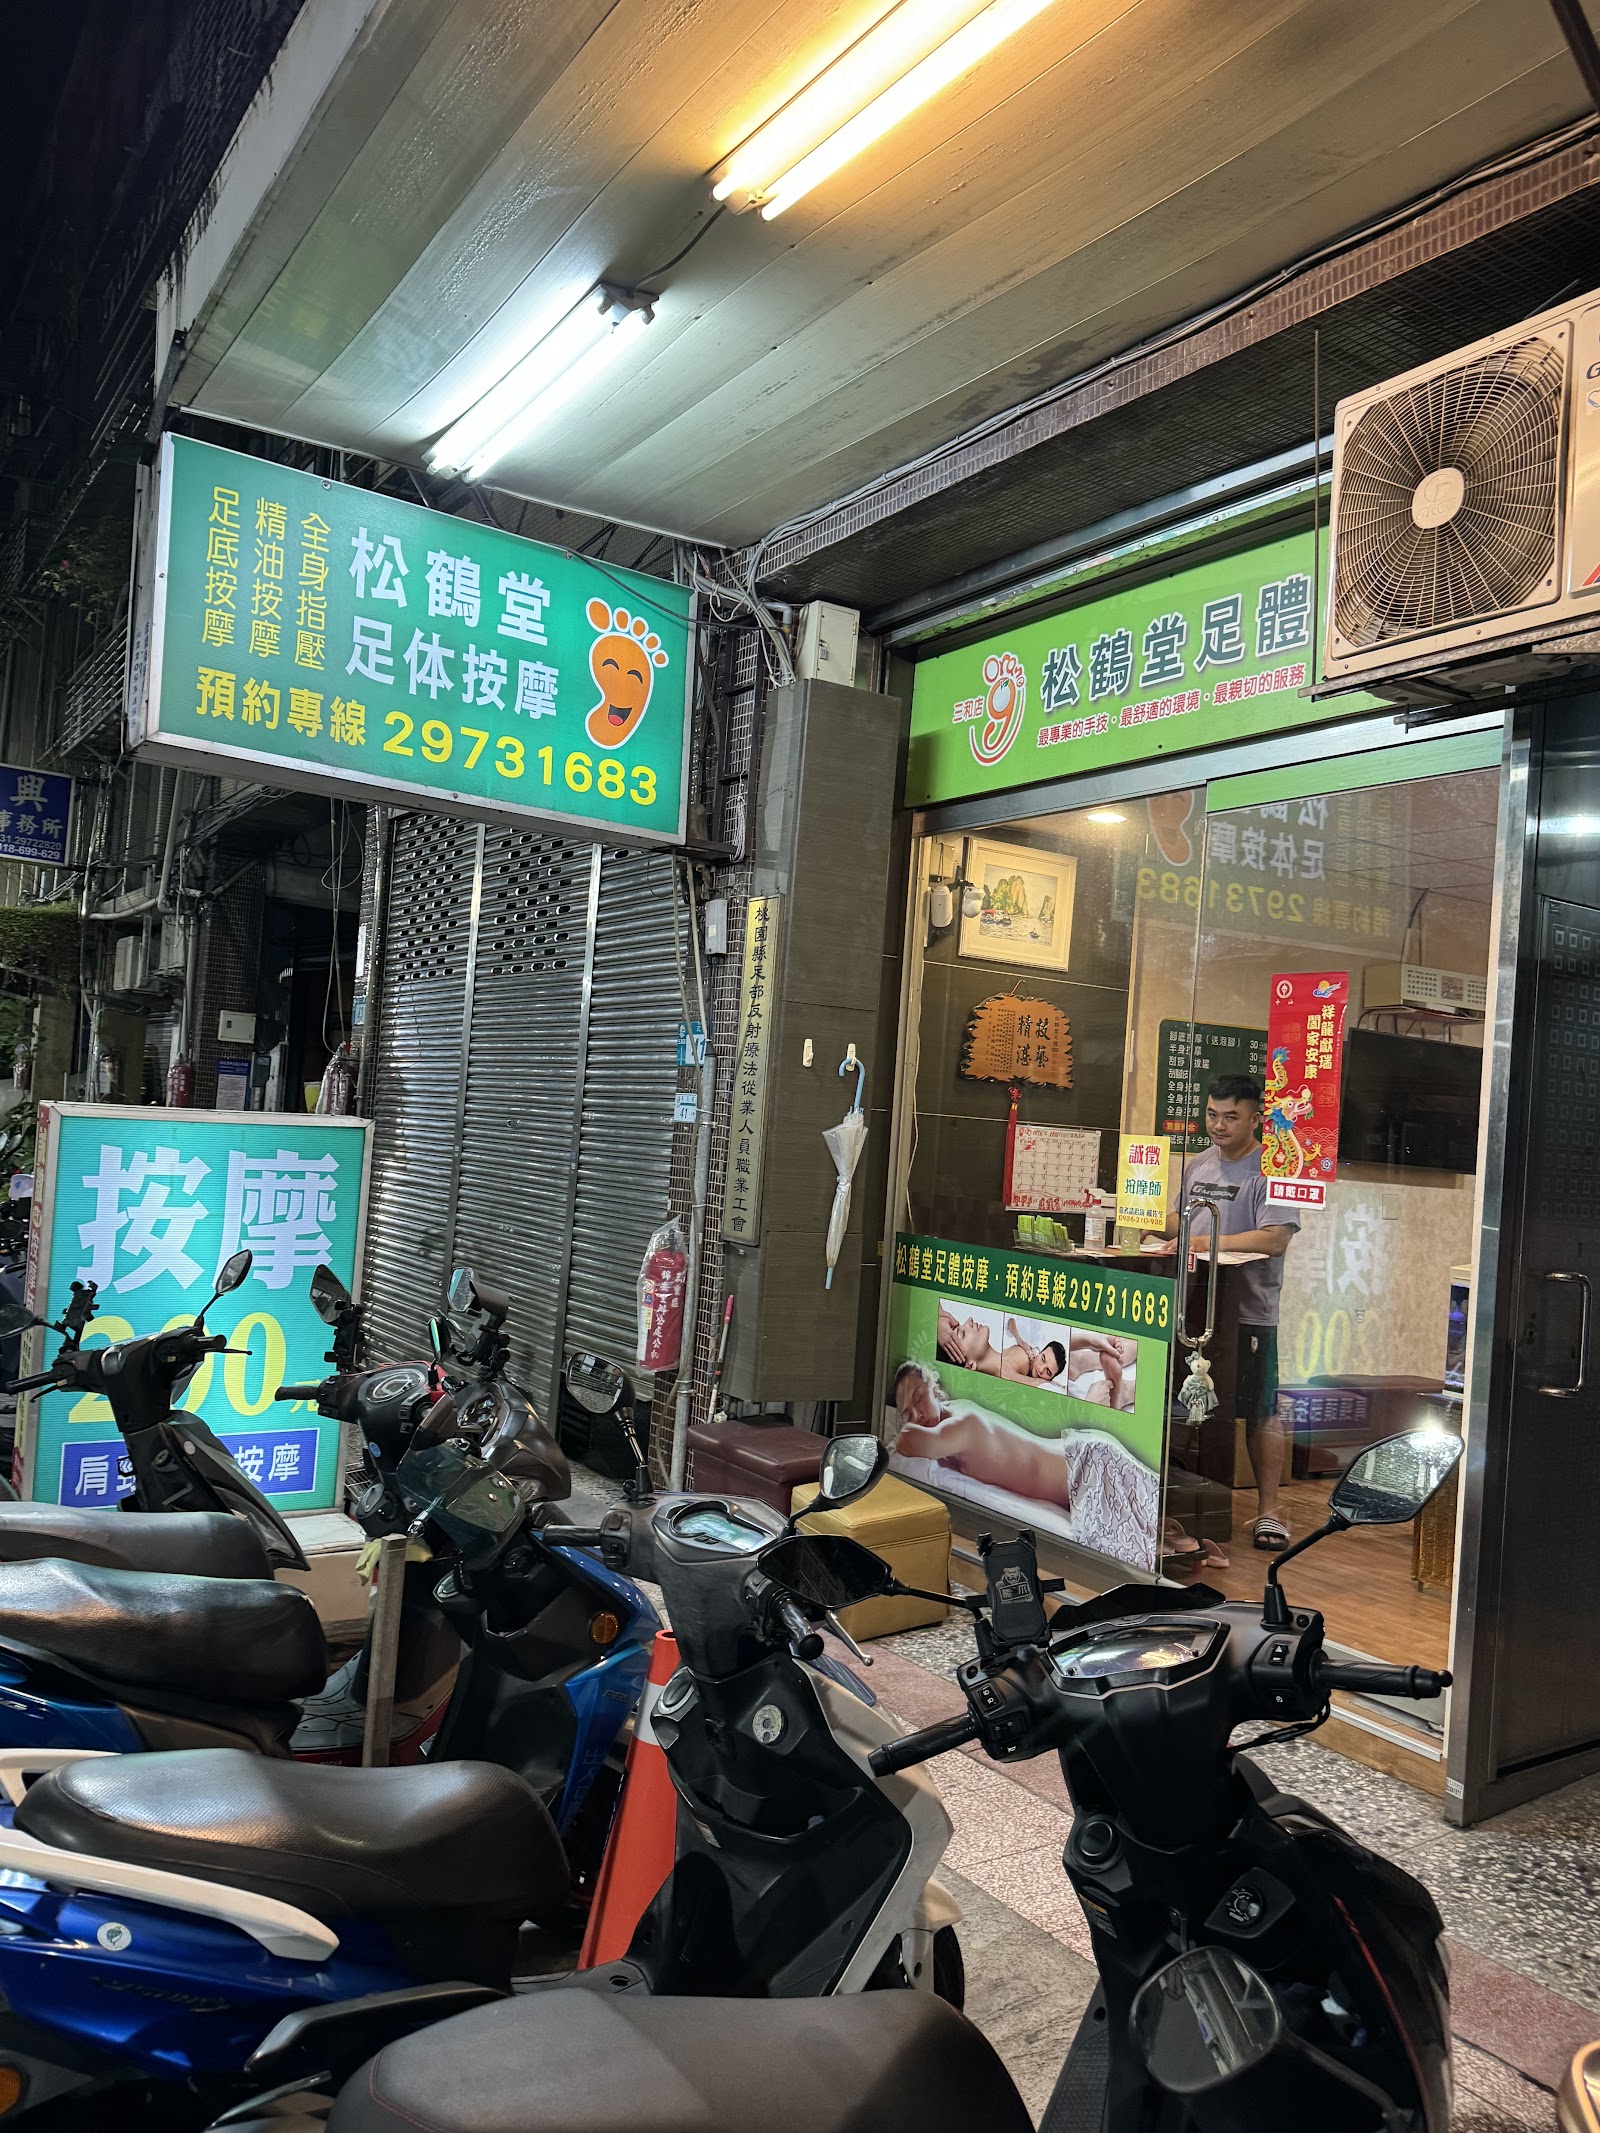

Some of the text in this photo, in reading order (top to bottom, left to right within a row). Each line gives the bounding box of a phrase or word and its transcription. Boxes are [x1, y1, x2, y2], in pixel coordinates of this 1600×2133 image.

[202, 486, 240, 648] 足底按摩
[249, 497, 287, 658] 精油按摩
[295, 512, 331, 671] 全身指壓
[348, 525, 551, 648] 松鶴堂
[345, 616, 560, 721] 足体按摩
[1041, 575, 1311, 711] 松鶴堂足體
[196, 666, 367, 747] 預約專線
[382, 710, 657, 806] 29731683
[953, 698, 983, 722] 三和店
[10, 774, 48, 812] 興
[731, 907, 771, 1232] 桃園縣足部反射療法從業人員職業工會
[1319, 1004, 1335, 1070] 祥龍獻瑞
[1125, 1179, 1162, 1196] 按摩師
[1129, 1144, 1160, 1165] 誠徵
[1273, 1184, 1320, 1200] 請戴口罩
[76, 1144, 341, 1293] 按摩
